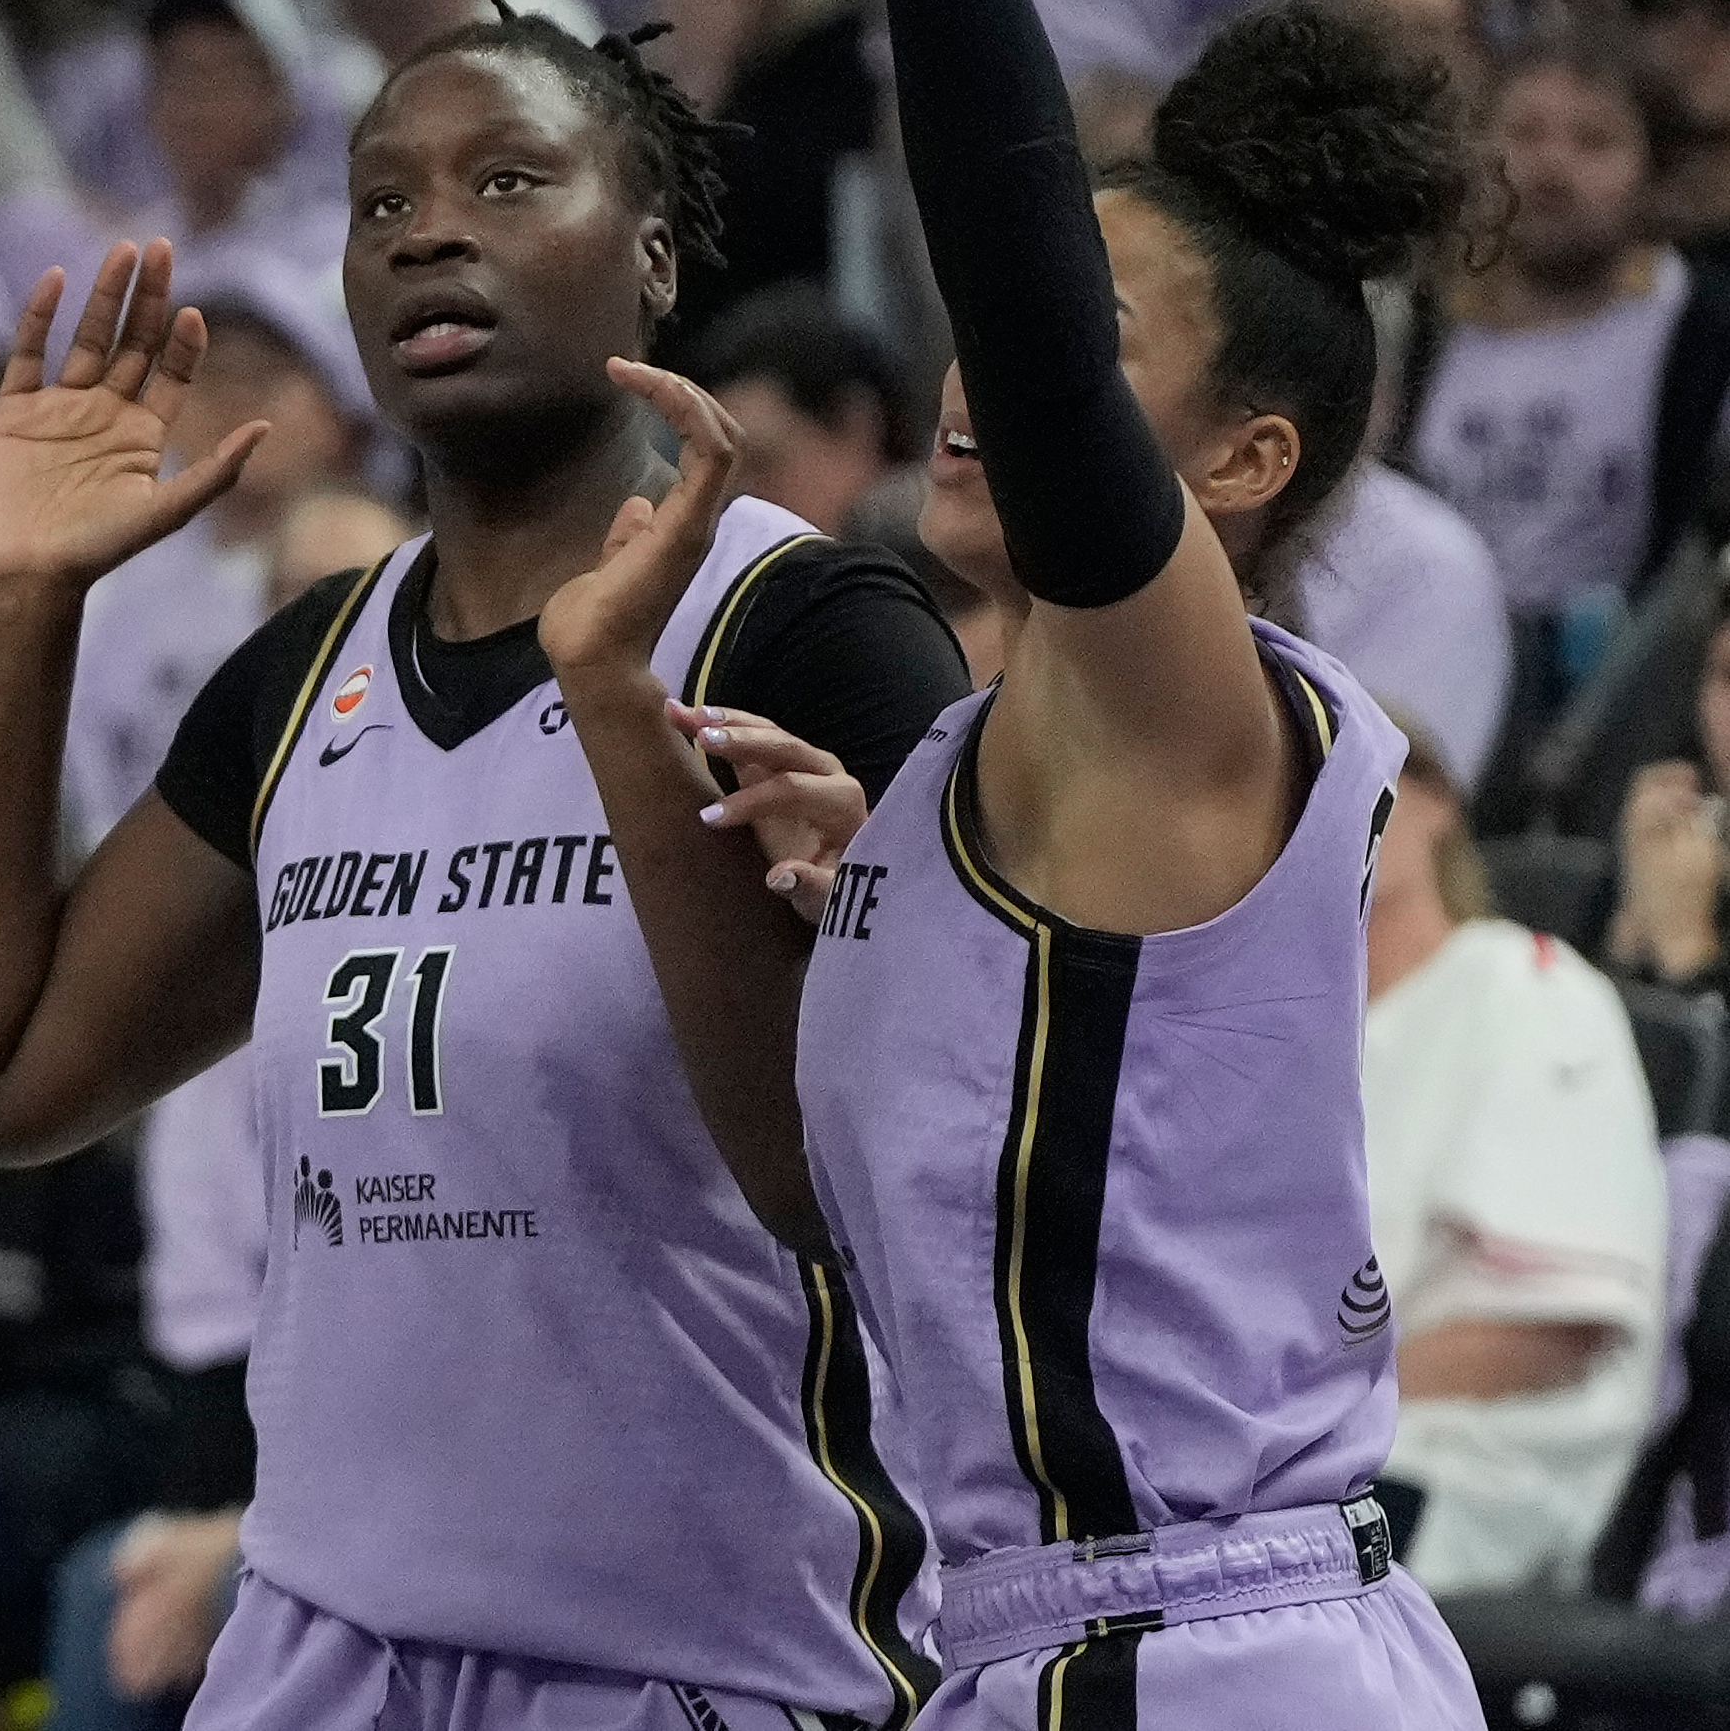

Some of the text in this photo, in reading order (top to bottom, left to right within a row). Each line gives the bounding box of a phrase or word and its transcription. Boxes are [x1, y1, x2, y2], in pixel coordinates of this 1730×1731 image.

[265, 834, 616, 934] GOLDEN STATE
[822, 862, 889, 941] ATE
[317, 945, 458, 1119] 31
[355, 1173, 436, 1206] KAISER
[359, 1209, 539, 1244] PERMANENTE
